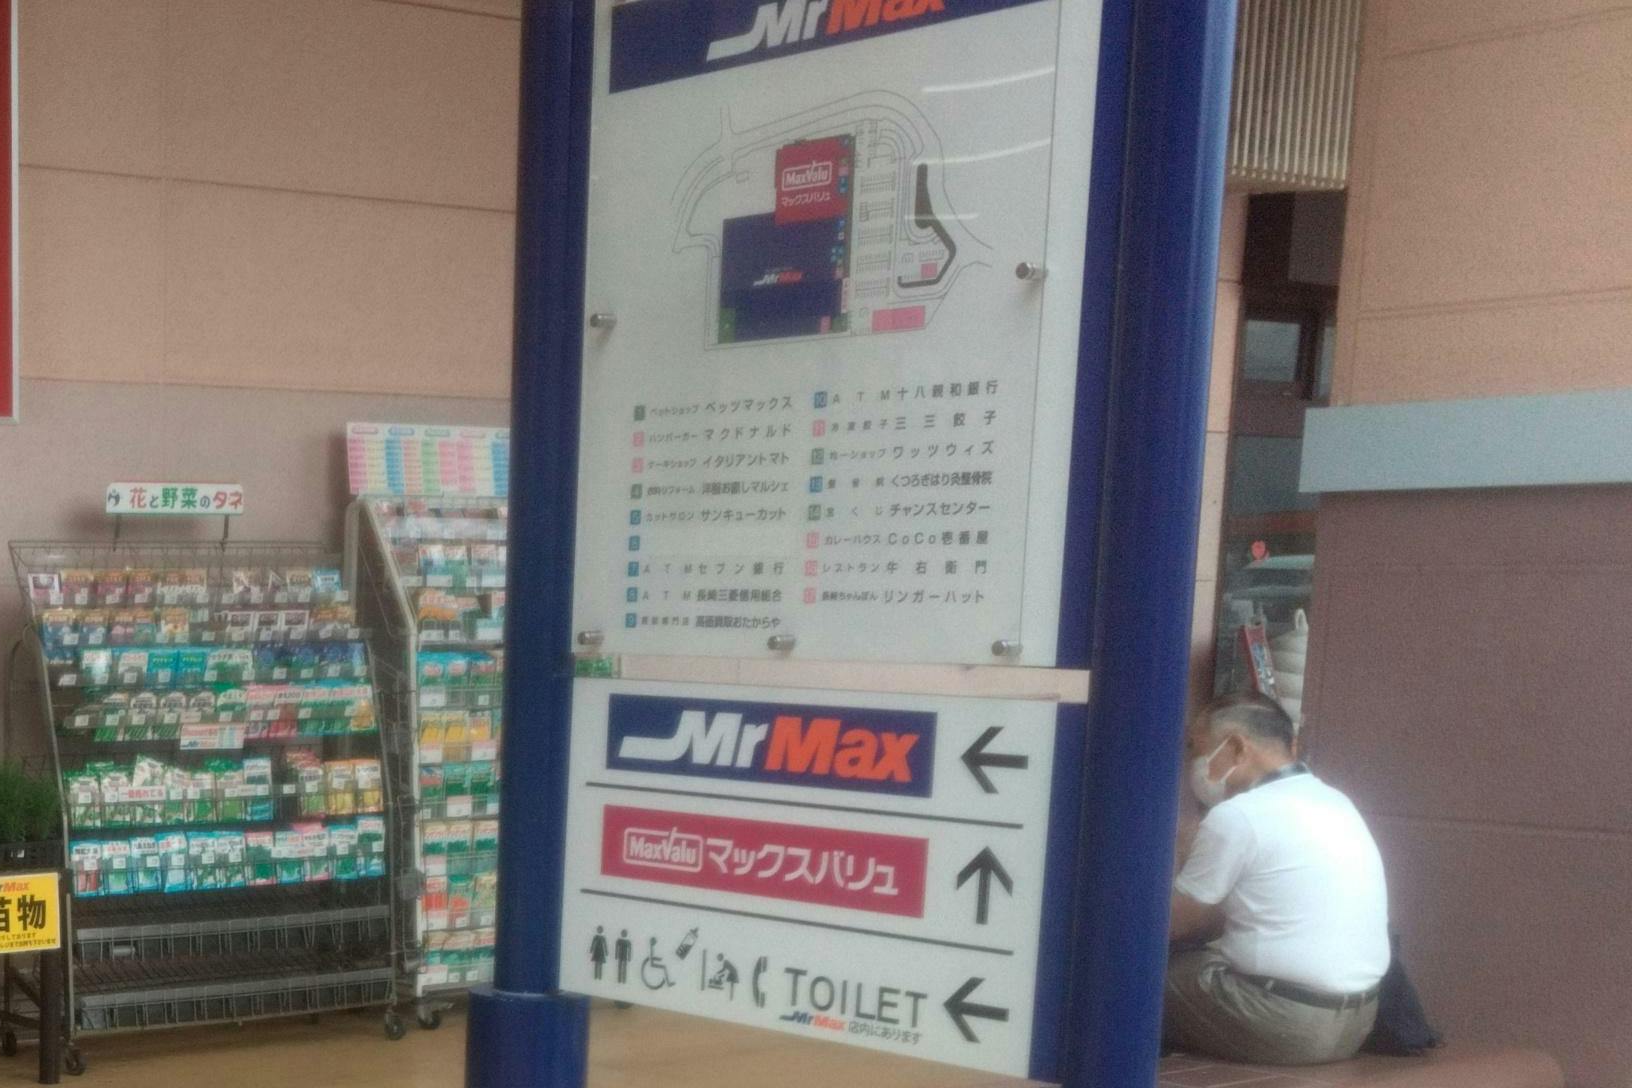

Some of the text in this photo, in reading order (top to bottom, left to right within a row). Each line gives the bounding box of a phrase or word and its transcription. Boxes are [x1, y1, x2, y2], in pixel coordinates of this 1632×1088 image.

[704, 423, 791, 440] マクドナルド
[892, 440, 994, 460] ワッツウィズ
[702, 451, 789, 468] イタリアントマト
[129, 487, 243, 509] 花と野菜のタネ
[700, 507, 786, 522] サンキューカット
[889, 501, 991, 517] チャンスセンター
[698, 561, 784, 575] セブン銀行
[822, 562, 880, 574] レストラン
[883, 589, 984, 604] リンガーハット
[619, 709, 920, 783] MrMax
[629, 830, 696, 865] MaxValu
[706, 838, 898, 896] マックスバリュ
[784, 967, 927, 1028] TOILET
[779, 1010, 845, 1032] MrMax
